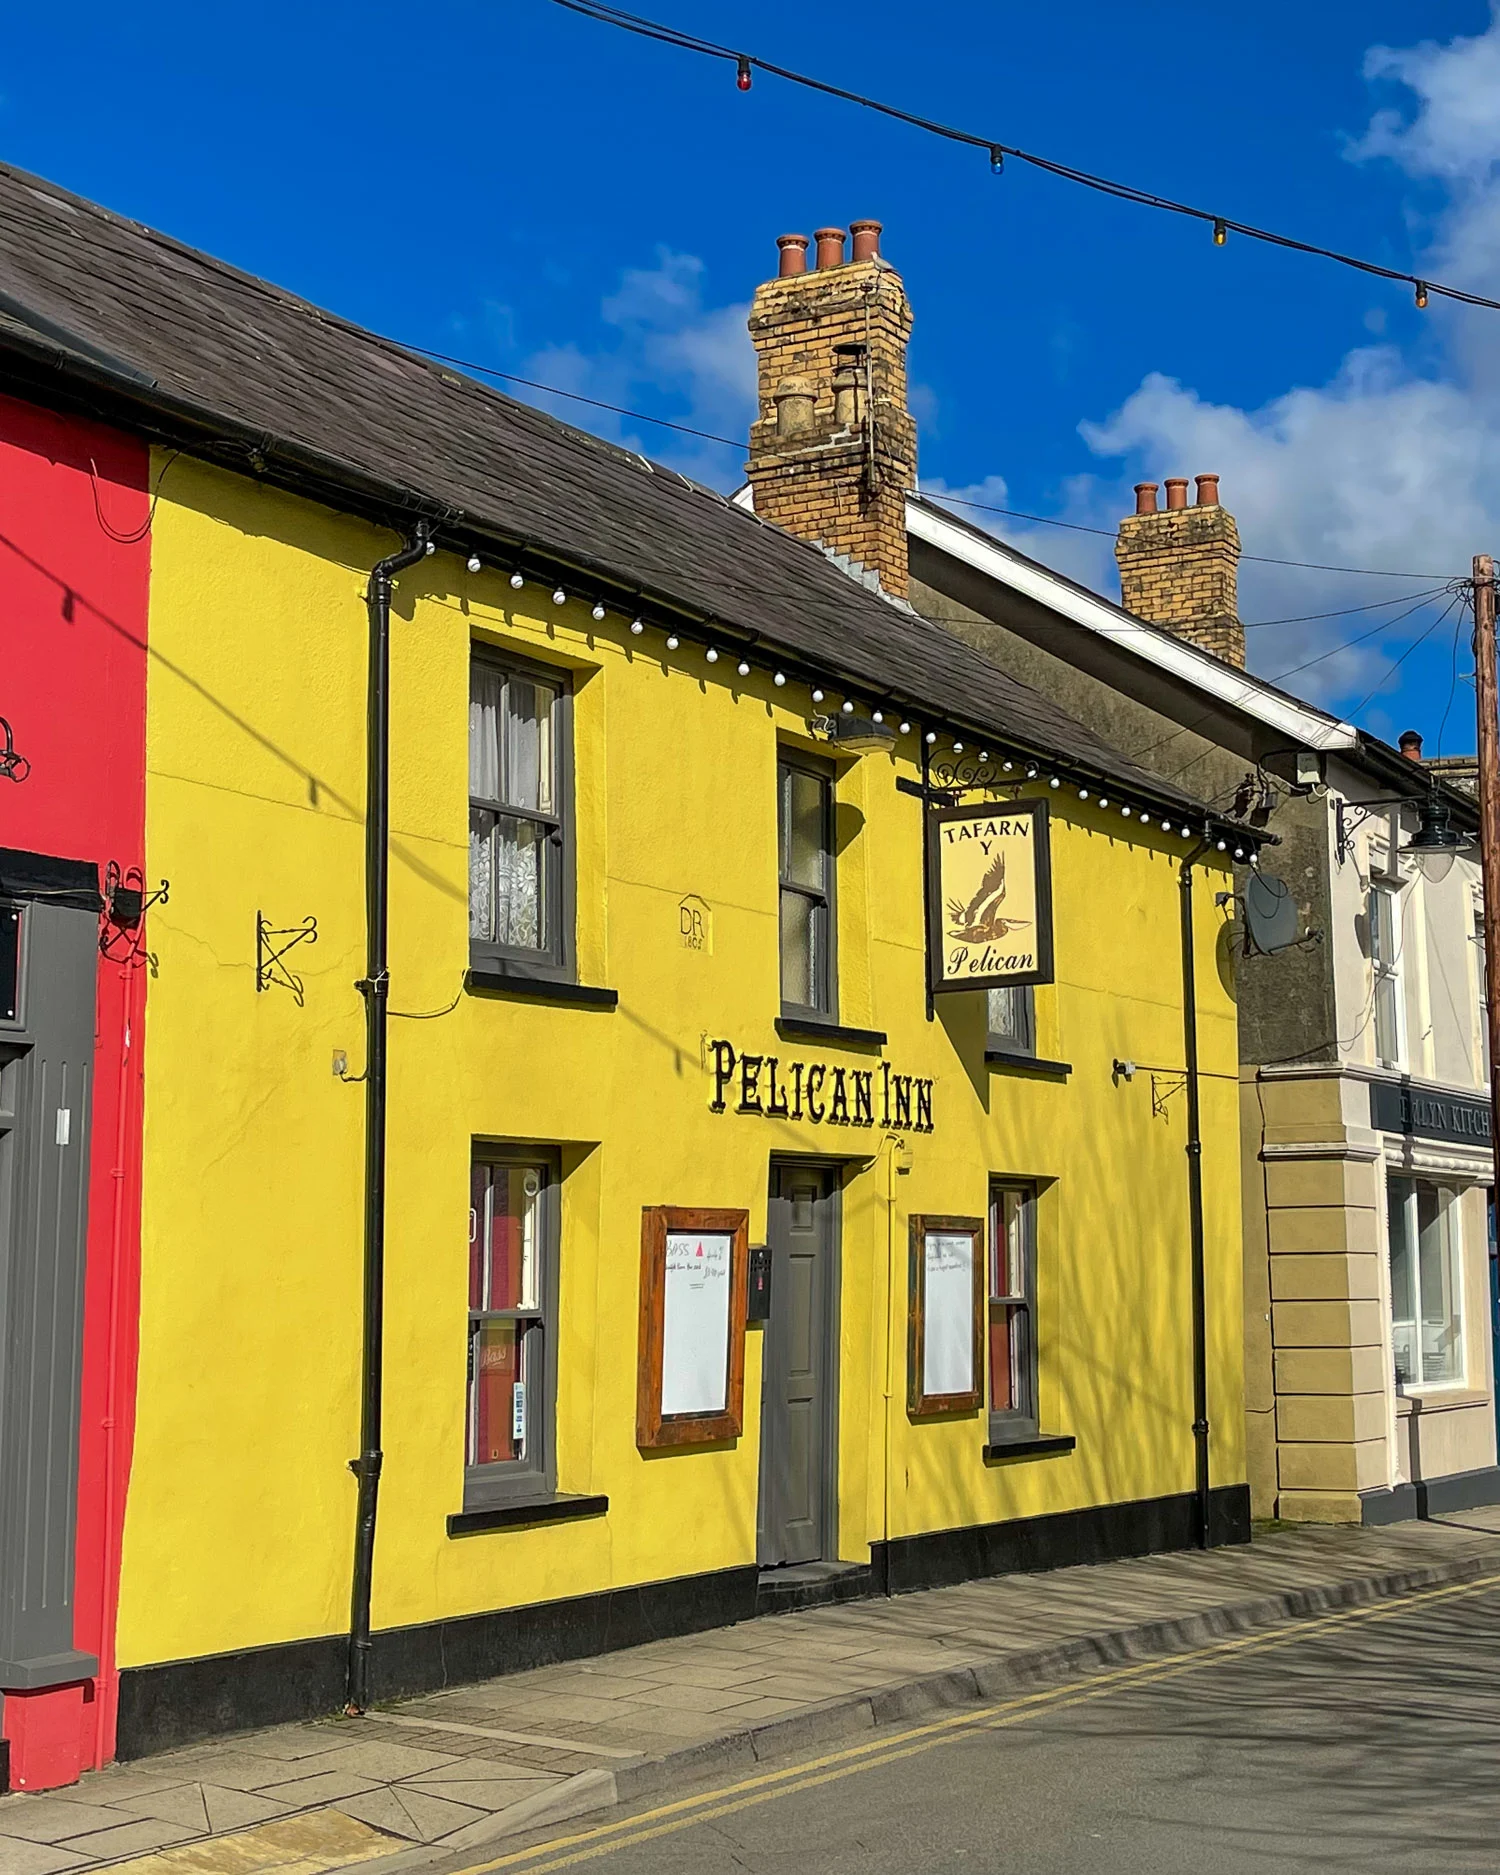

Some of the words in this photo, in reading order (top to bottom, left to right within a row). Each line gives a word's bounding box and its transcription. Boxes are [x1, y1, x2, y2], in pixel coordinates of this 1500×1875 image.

[944, 821, 1030, 844] TAFARN
[980, 841, 993, 856] Y
[680, 907, 705, 939] DR
[947, 945, 1034, 975] Pelican
[709, 1040, 875, 1127] PELICAN
[877, 1060, 934, 1133] INN
